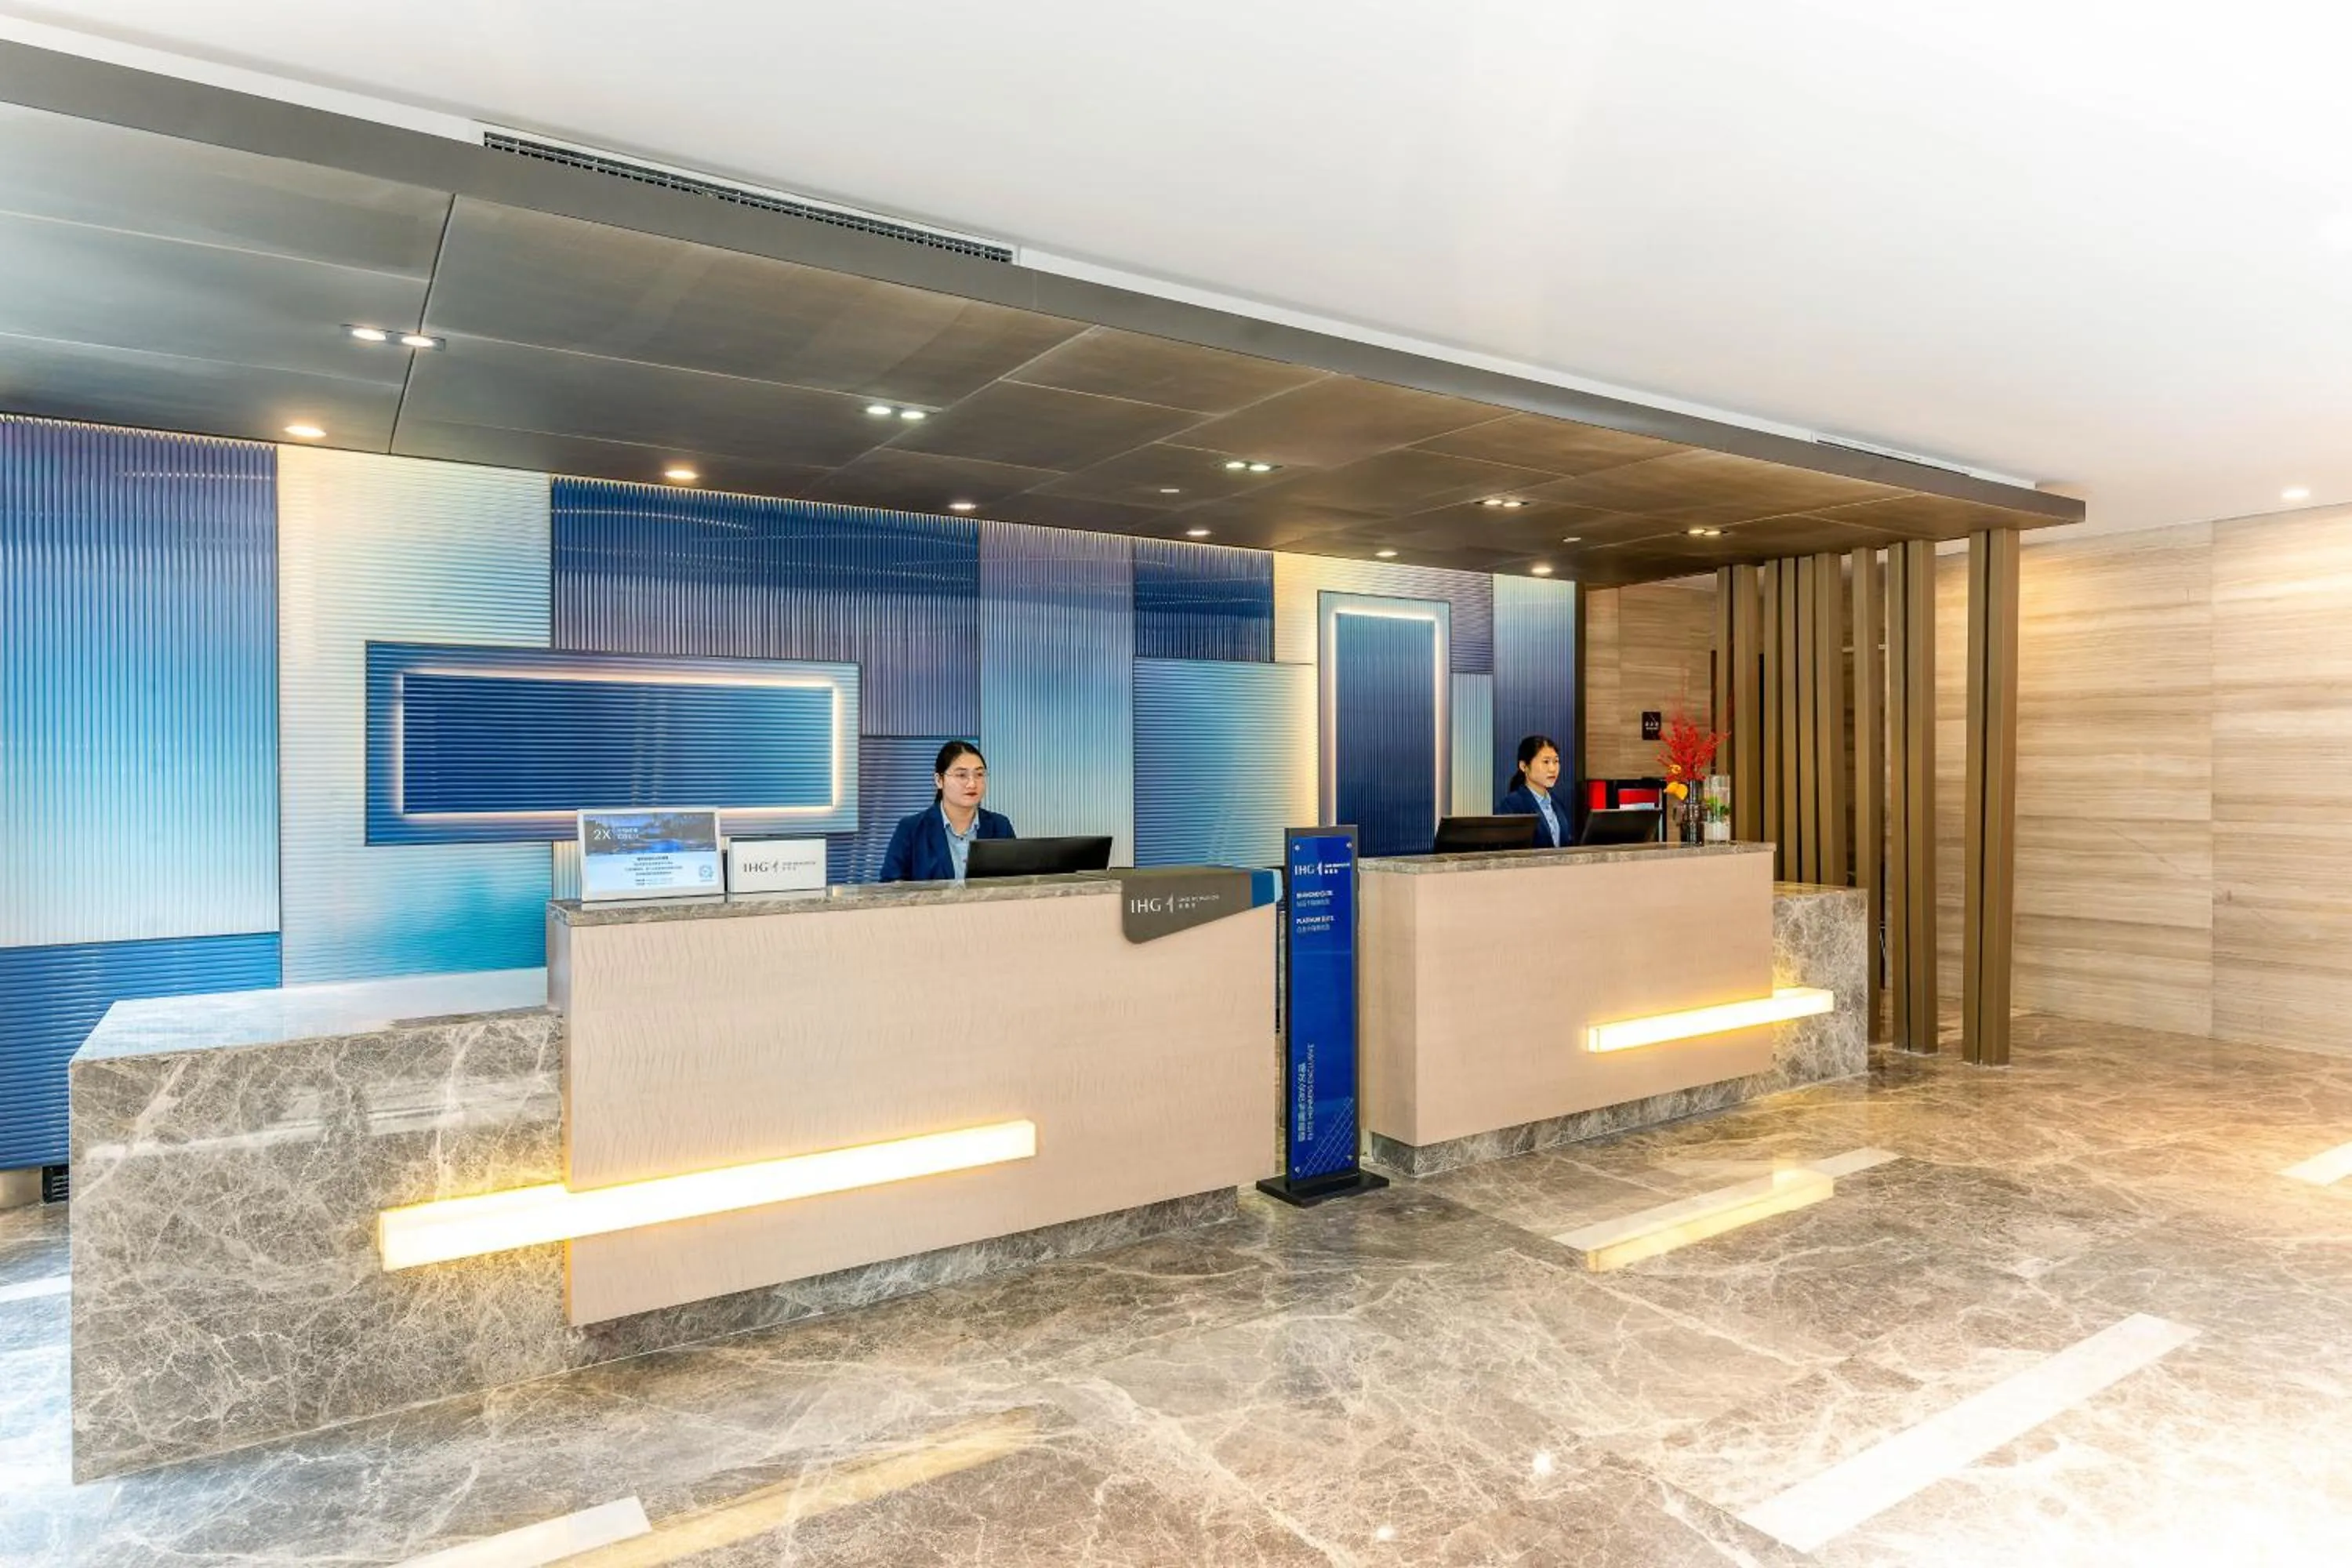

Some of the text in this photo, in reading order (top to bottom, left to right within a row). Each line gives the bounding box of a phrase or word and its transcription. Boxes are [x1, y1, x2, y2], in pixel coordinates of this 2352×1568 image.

[593, 828, 612, 840] 2X
[744, 862, 768, 873] IHG
[1294, 864, 1315, 876] IHG
[1131, 898, 1161, 913] IHG
